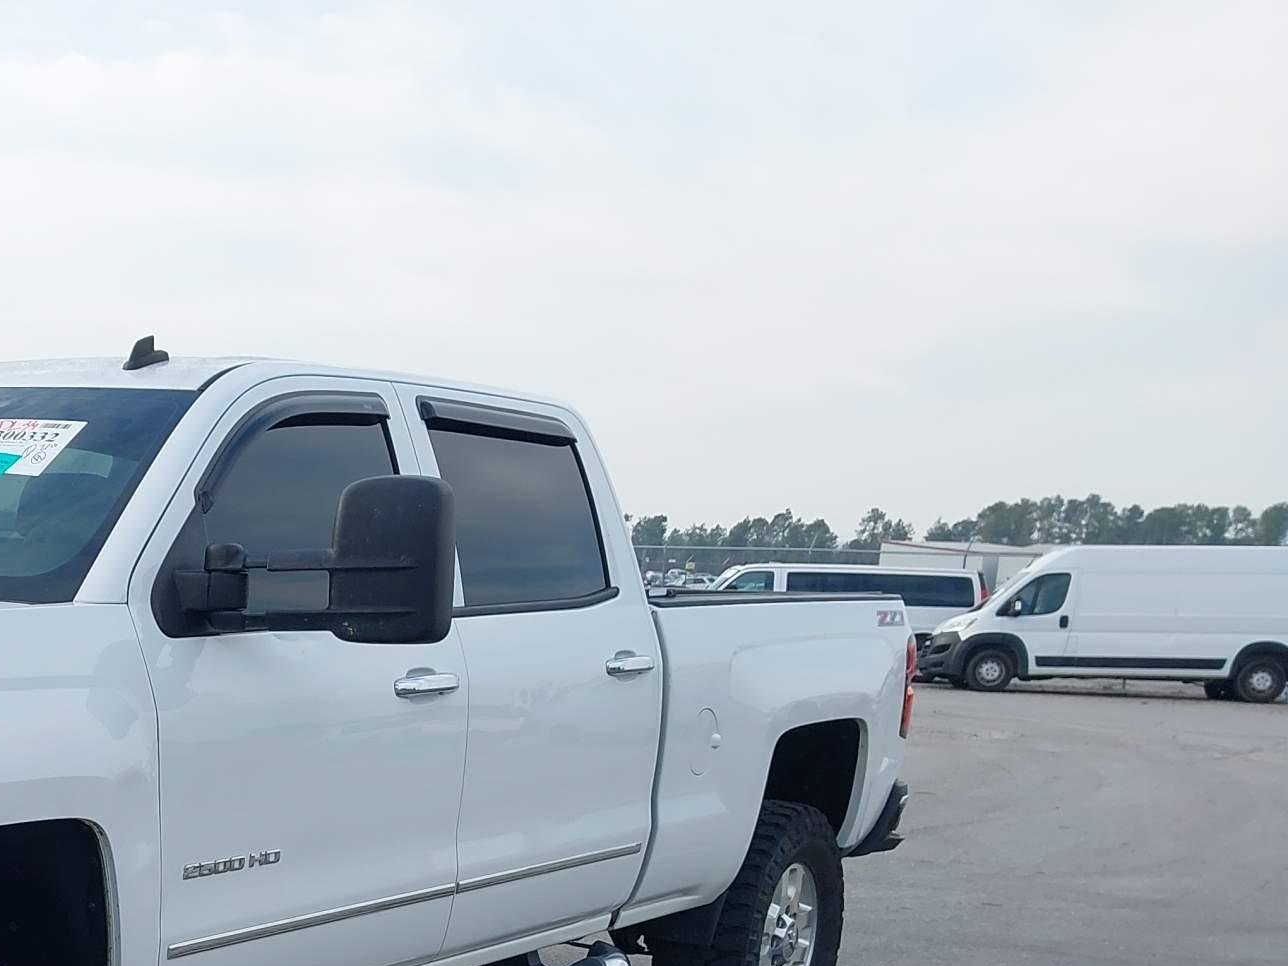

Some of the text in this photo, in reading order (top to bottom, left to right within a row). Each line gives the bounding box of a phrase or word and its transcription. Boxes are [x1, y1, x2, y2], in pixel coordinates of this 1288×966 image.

[876, 610, 905, 626] Z71
[182, 849, 281, 880] 2500 HD
